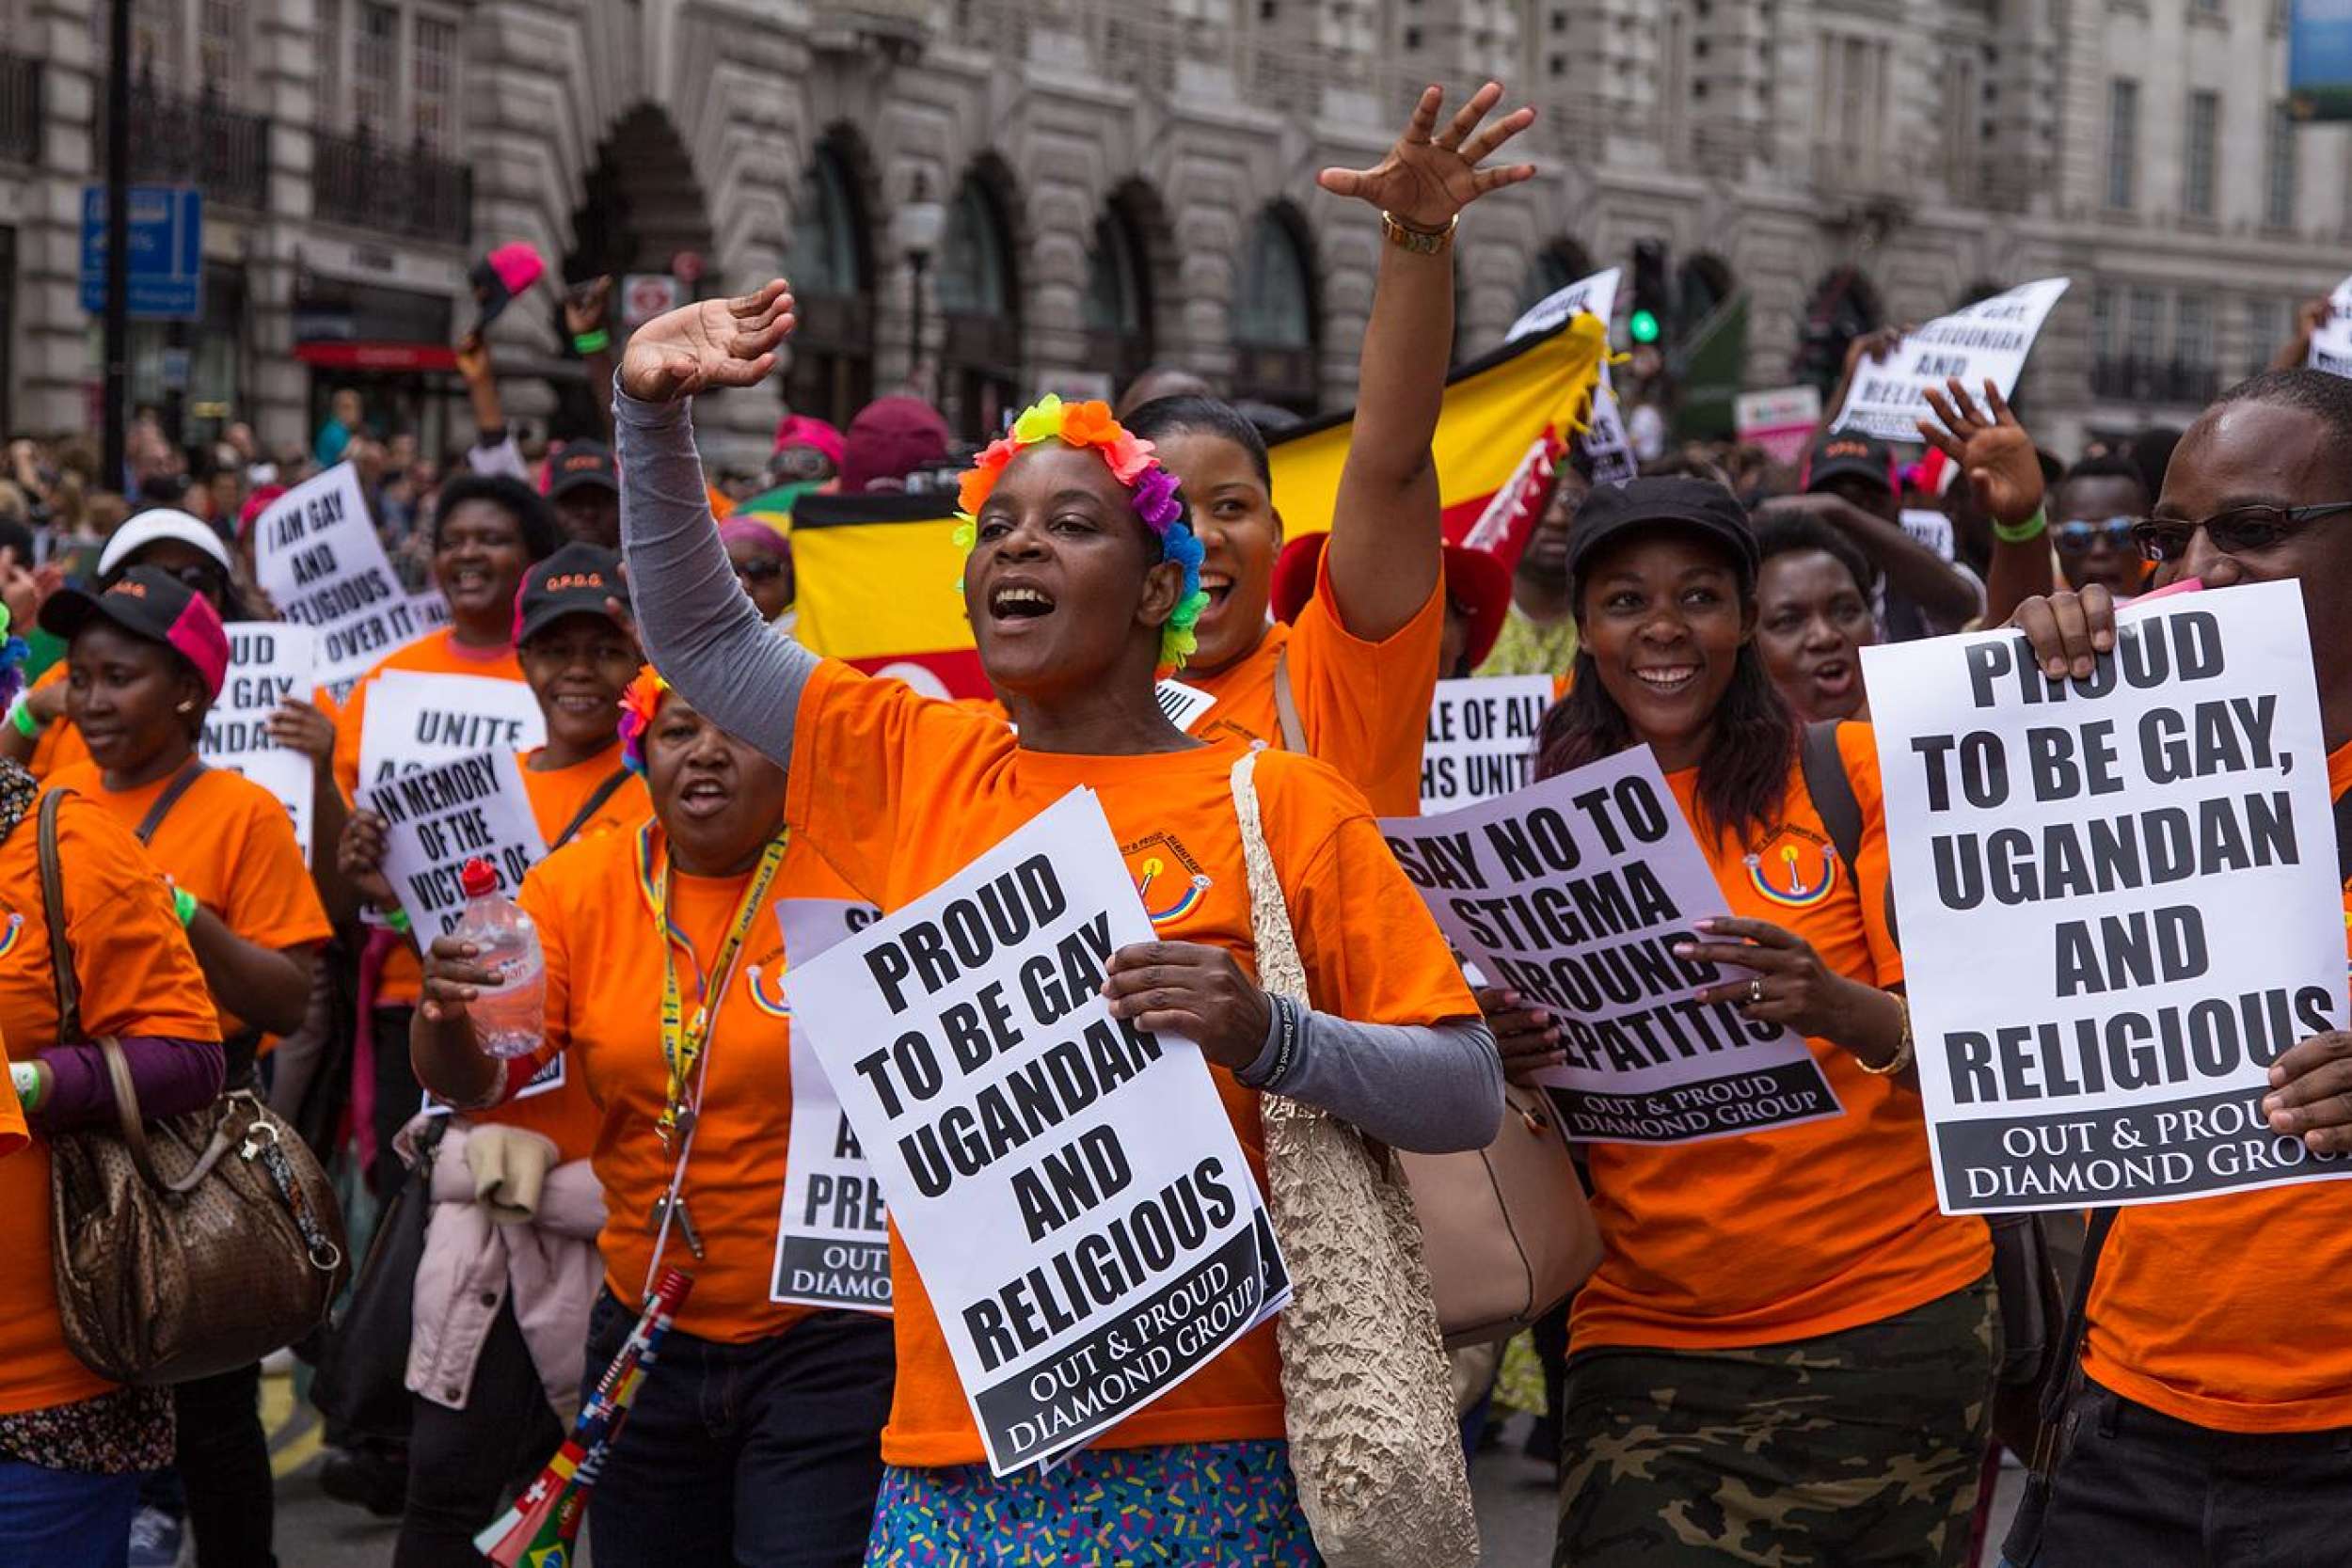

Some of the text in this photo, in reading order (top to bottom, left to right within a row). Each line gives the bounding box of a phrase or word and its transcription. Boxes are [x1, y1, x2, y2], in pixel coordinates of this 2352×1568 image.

[278, 509, 306, 547] AM
[307, 490, 345, 531] GAY
[283, 566, 391, 627] ELIGIOUS
[291, 541, 338, 588] AND
[326, 612, 390, 663] OVER
[387, 601, 415, 640] IT
[1464, 698, 1497, 740] OF
[1911, 694, 2294, 812] TO BE GAY,
[371, 784, 407, 826] IN
[400, 752, 501, 817] MEMORY
[1466, 753, 1530, 797] UNIT
[416, 805, 495, 862] OF THE
[1385, 832, 1488, 890] SAY
[1483, 807, 1582, 882] NO
[1572, 776, 1670, 856] TO
[1931, 790, 2300, 911] UGANDAN
[863, 853, 1067, 1015] PROUD
[1449, 860, 1681, 953] STIGMA
[2055, 905, 2209, 997] AND
[853, 910, 1116, 1120] TO BE GAY
[1943, 985, 2336, 1104] RELIGIOUS
[898, 1018, 1163, 1198] UGANDAN
[1574, 1091, 1819, 1138] DIAMOND GROUP
[1583, 1075, 1778, 1117] OUT & PROUD
[2003, 1099, 2271, 1158] OUT & PROU
[803, 1172, 886, 1230] PRE
[1010, 1123, 1132, 1244] AND
[1964, 1152, 2195, 1199] DIAMOND
[791, 1271, 893, 1300] DIAMO
[823, 1246, 888, 1274] OUT
[961, 1156, 1236, 1373] RELIGIOUS
[1006, 1275, 1255, 1455] DIAMOND GROUP
[1029, 1343, 1097, 1403] OUT
[1106, 1330, 1136, 1361] &
[1132, 1261, 1231, 1343] PROUD
